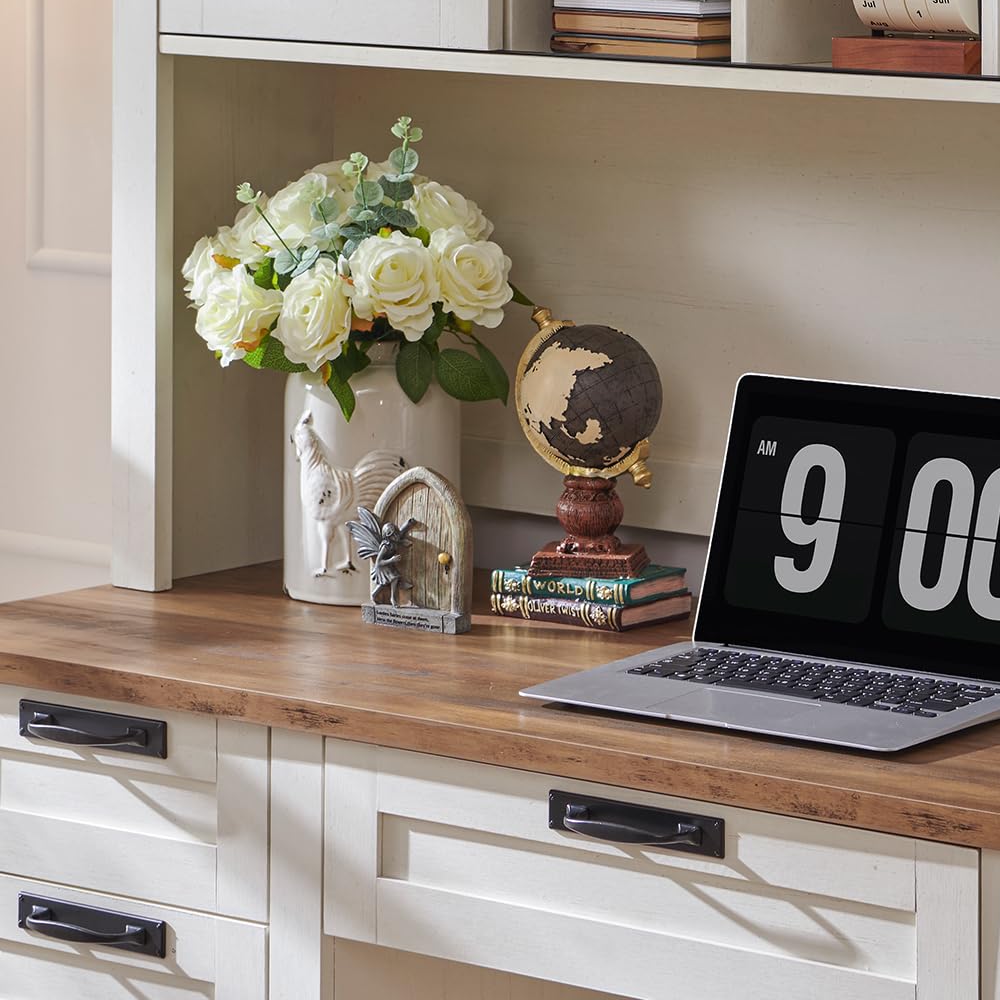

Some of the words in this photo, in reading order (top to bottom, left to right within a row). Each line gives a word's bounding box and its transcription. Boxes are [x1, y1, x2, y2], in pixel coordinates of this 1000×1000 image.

[862, 0, 877, 9] Jul
[916, 10, 923, 18] 1
[757, 439, 777, 457] AM
[773, 443, 847, 593] 9
[533, 580, 584, 596] WORLD
[528, 602, 556, 614] OLIVER
[557, 605, 581, 617] TWIST
